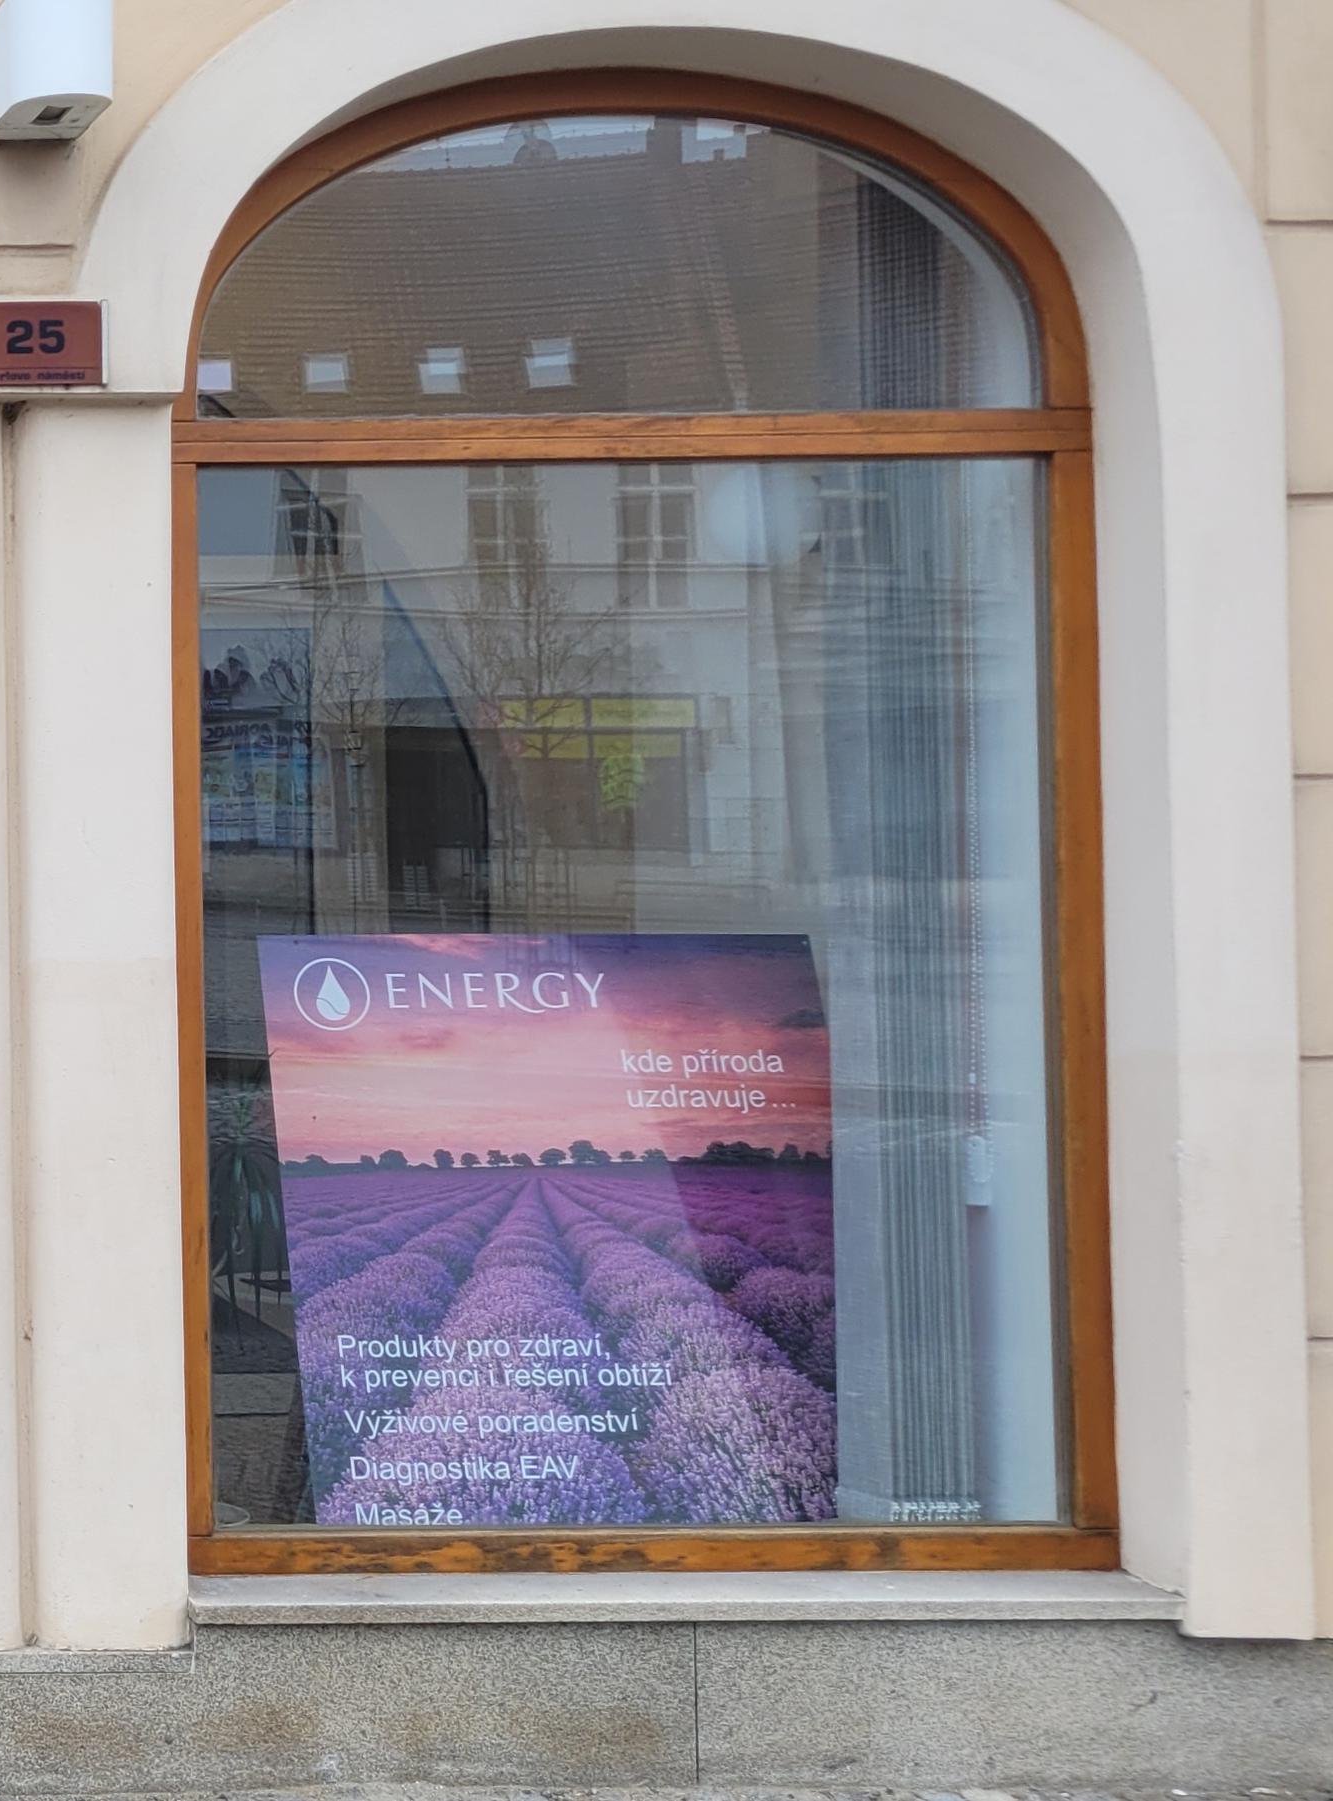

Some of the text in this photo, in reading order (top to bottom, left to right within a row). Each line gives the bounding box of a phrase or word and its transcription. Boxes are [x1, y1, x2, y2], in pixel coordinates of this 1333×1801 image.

[6, 319, 65, 354] 25
[37, 370, 85, 380] náměstí
[385, 972, 605, 1013] ENERGY
[621, 1049, 784, 1078] kde příroda
[337, 1333, 611, 1363] Produkty pro zdraví,
[340, 1365, 356, 1387] k
[365, 1366, 479, 1393] prevenci
[504, 1364, 589, 1387] řešení
[598, 1363, 672, 1387] obtíží
[344, 1408, 638, 1439] Výživové poradenství
[349, 1456, 579, 1485] Diagnostika EAV
[354, 1502, 464, 1526] Masáže
